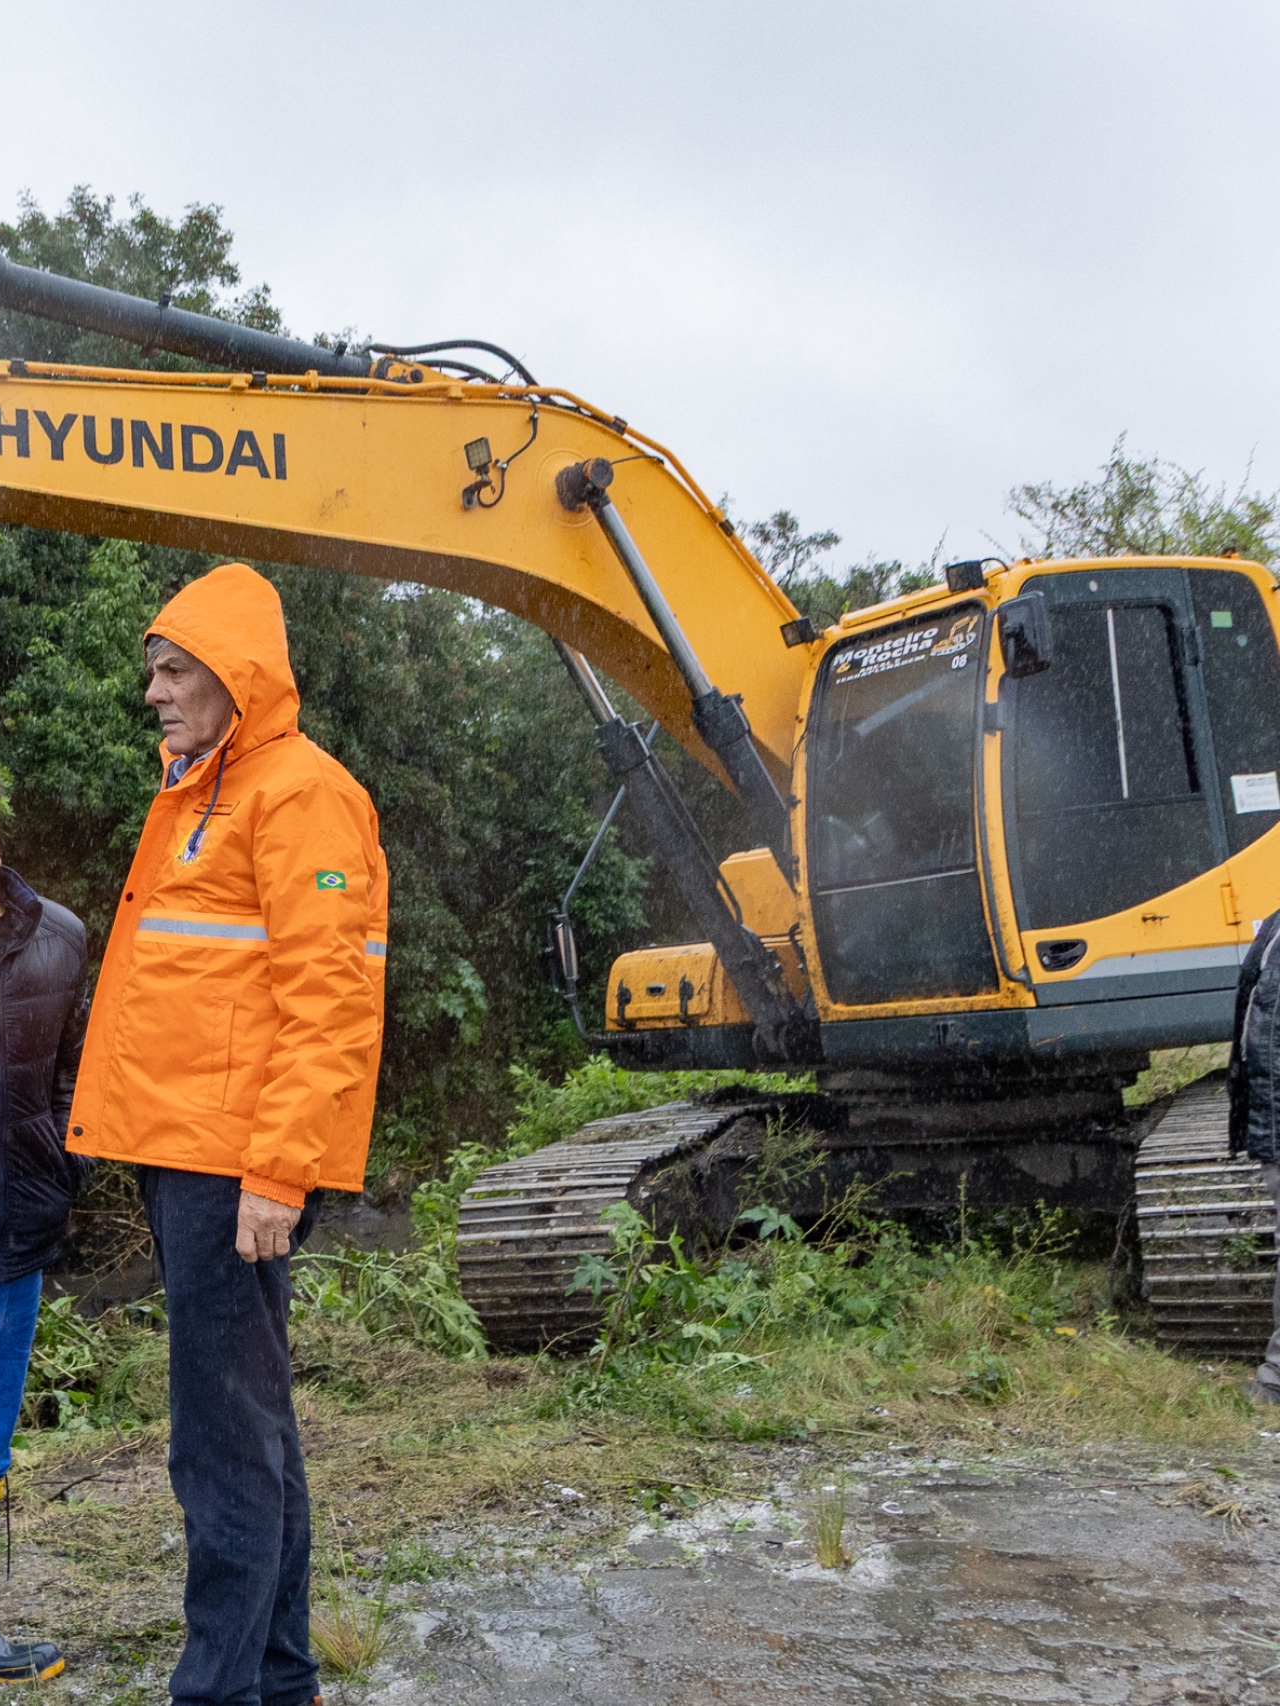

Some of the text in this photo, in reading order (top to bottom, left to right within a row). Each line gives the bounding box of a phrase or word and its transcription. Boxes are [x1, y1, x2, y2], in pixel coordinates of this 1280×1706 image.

[833, 627, 939, 666] Monteiro
[861, 638, 933, 667] Rocha
[951, 653, 967, 669] 08
